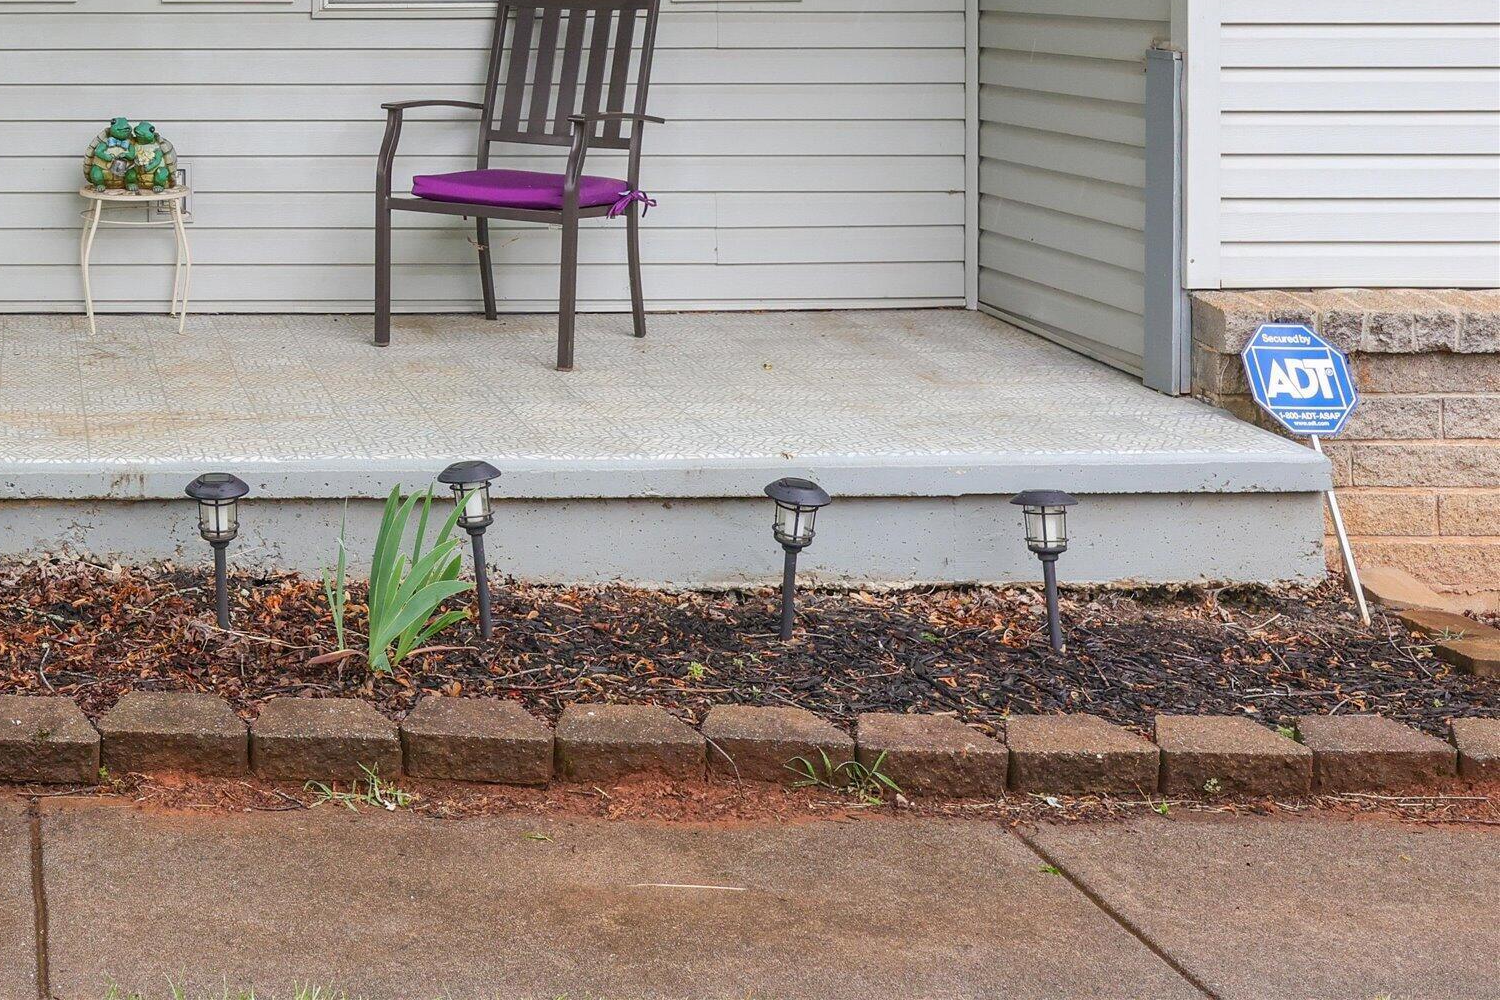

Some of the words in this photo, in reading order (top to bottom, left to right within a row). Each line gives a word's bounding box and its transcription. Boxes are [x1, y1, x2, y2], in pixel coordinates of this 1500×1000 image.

[1261, 333, 1299, 344] Secured
[1298, 334, 1311, 346] by
[1279, 411, 1341, 420] 1-800-ADT-ASAP
